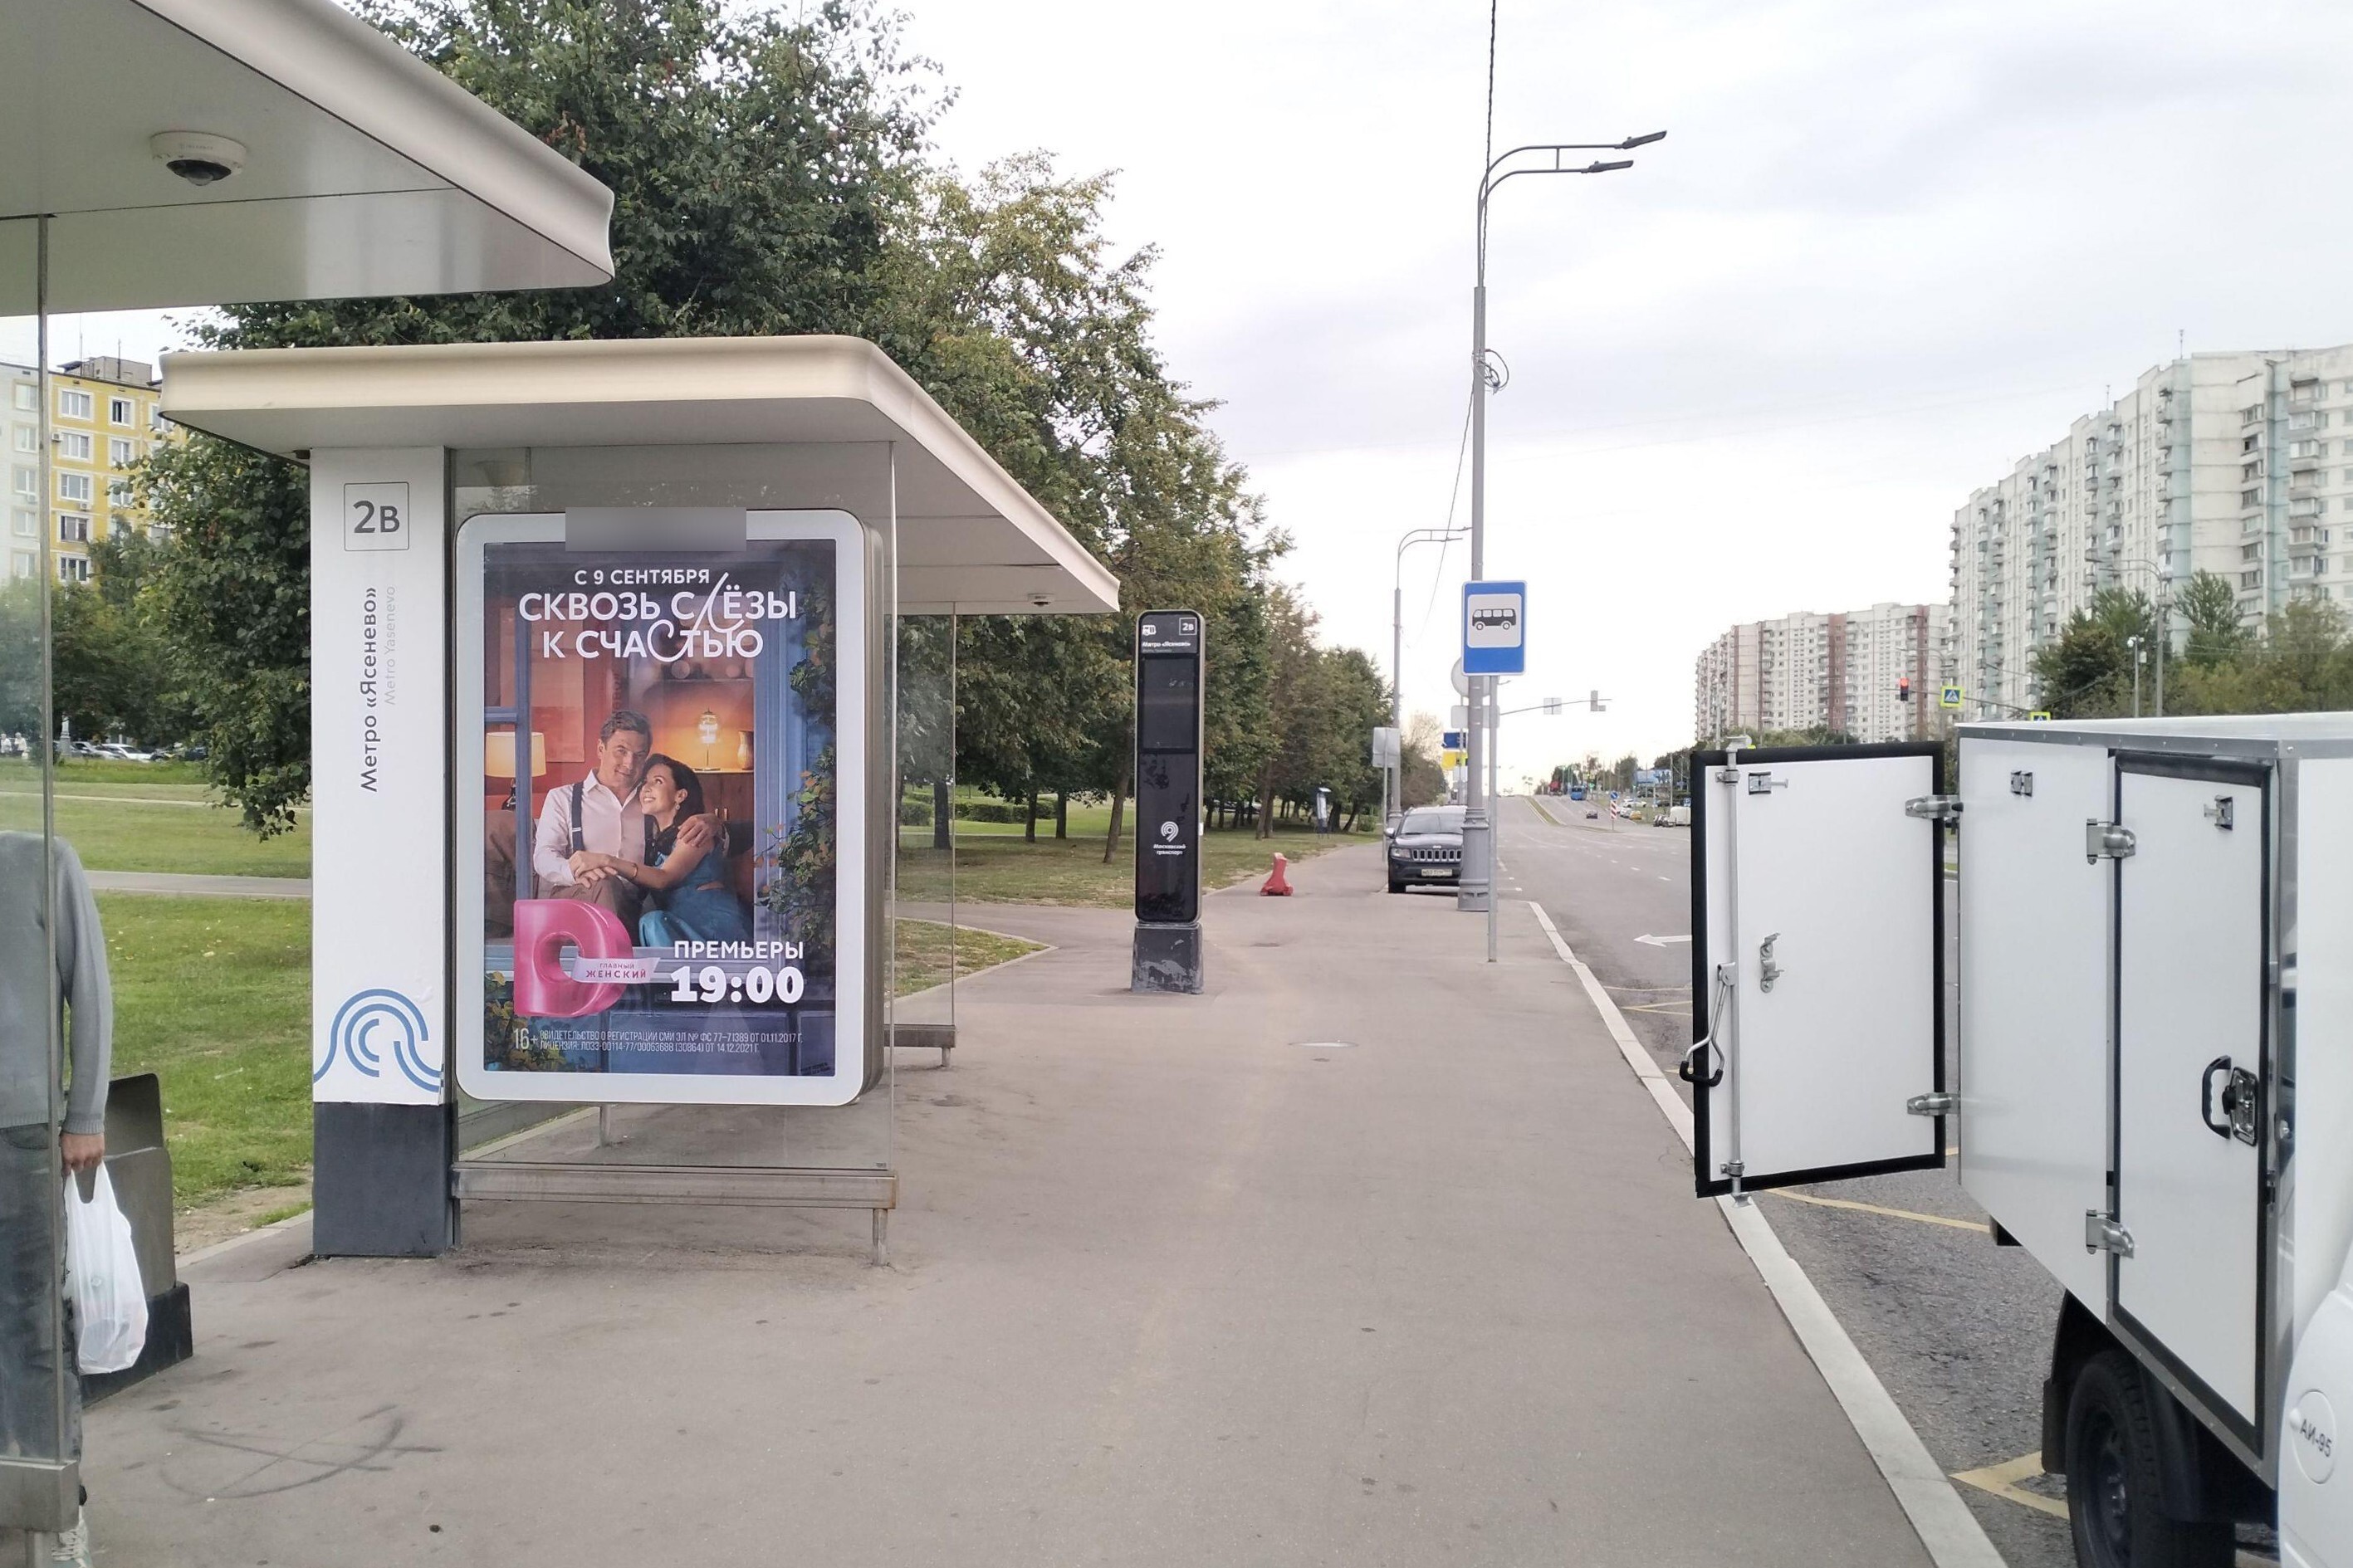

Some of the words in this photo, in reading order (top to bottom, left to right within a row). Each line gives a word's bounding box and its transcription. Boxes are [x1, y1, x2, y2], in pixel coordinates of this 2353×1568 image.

[574, 569, 588, 585] С
[593, 569, 604, 585] 9
[609, 568, 711, 585] СЕНТЯБРЯ
[384, 586, 396, 656] Yasenevo
[518, 591, 661, 622] СКВОЗЬ
[670, 571, 797, 634] СЛЁЗЫ
[359, 587, 377, 708] «Ясенево»
[542, 630, 566, 659] К
[575, 618, 765, 662] СЧАСТЬЮ
[384, 658, 396, 706] Metro
[360, 715, 381, 793] Метро
[673, 939, 805, 960] ПРЕМЬЕРЫ
[585, 969, 647, 979] ЖЕНСКИЙ
[670, 965, 805, 1004] 19:00
[512, 1028, 538, 1051] 16+
[607, 1031, 658, 1043] РЕГИСТРАЦИИ
[2299, 1418, 2333, 1458] АИ-95
